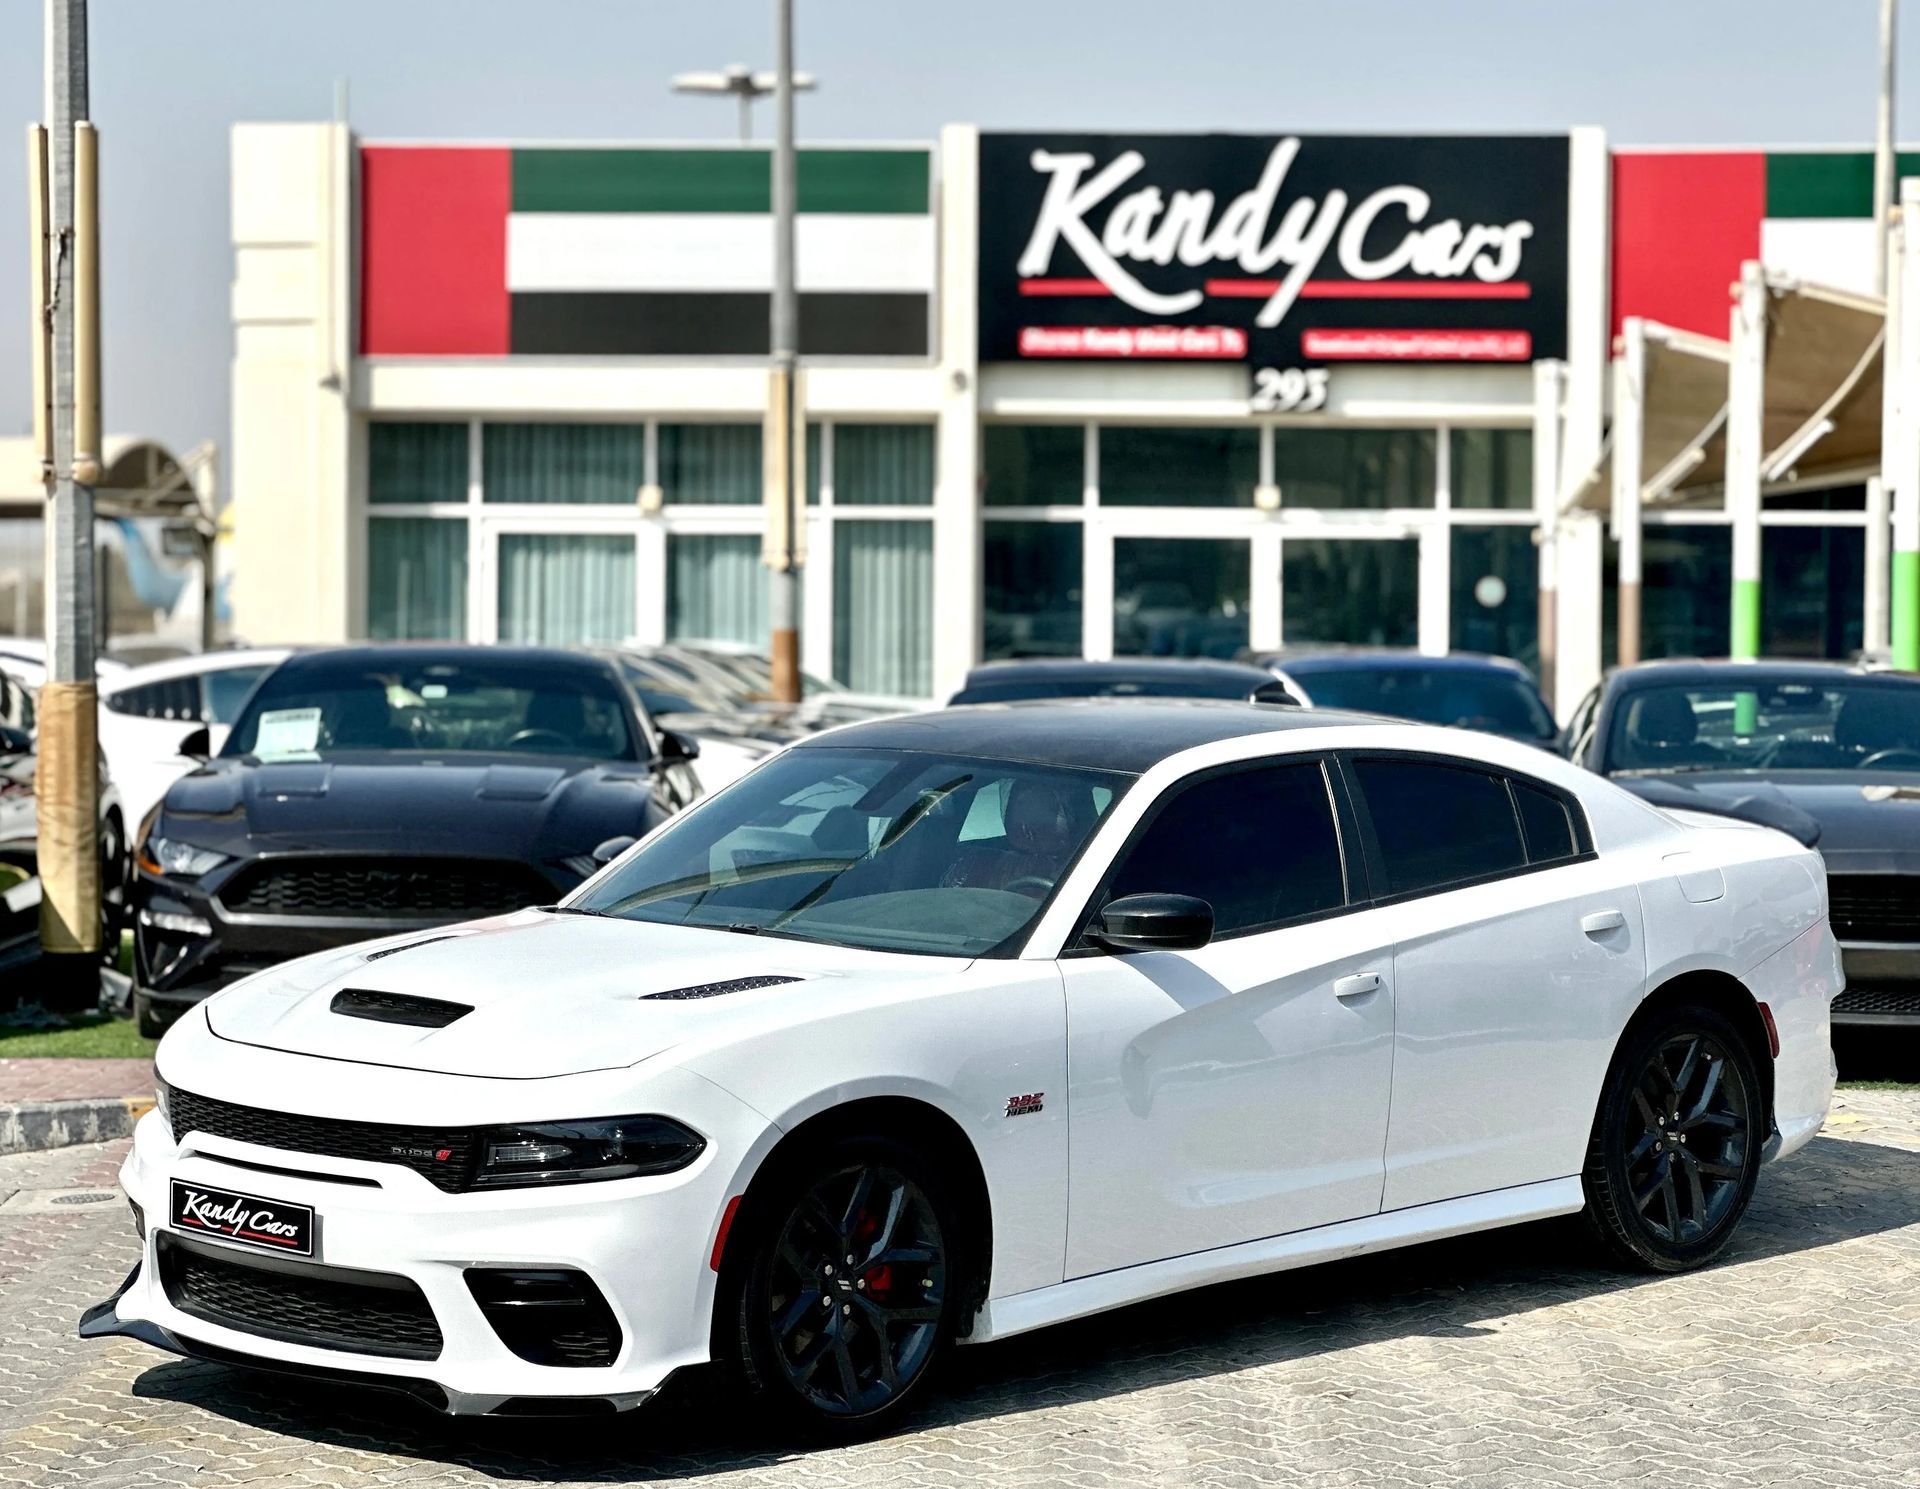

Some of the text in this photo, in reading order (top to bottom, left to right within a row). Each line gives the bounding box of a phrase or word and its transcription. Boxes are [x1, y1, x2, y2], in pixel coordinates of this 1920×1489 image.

[1018, 137, 1534, 327] Kandy Cars
[1251, 367, 1330, 411] 295
[1003, 1104, 1043, 1117] HEMI
[182, 1190, 299, 1237] Kandy Cars
